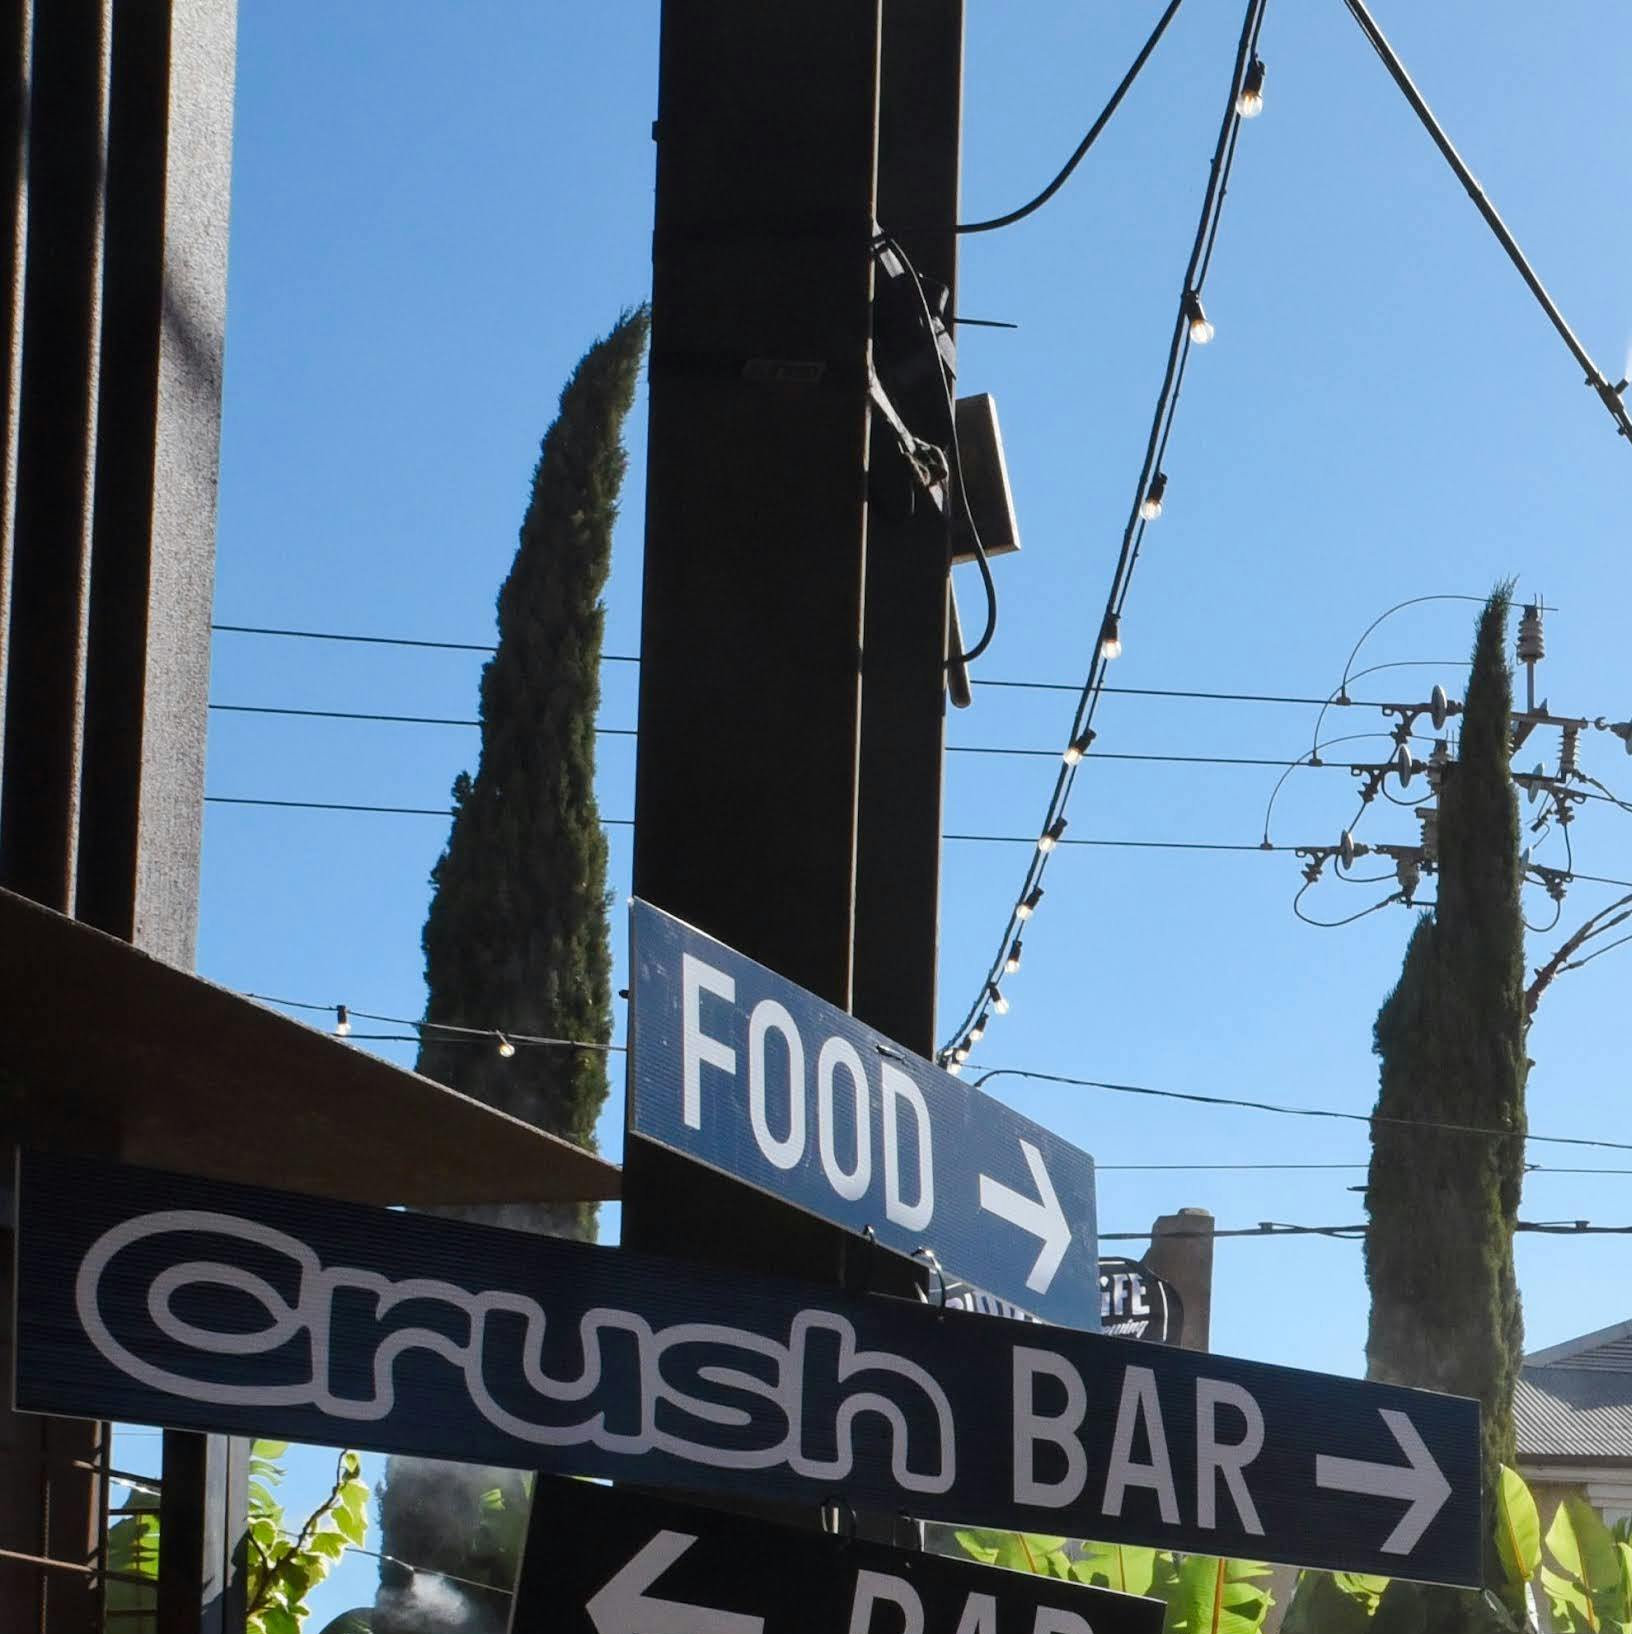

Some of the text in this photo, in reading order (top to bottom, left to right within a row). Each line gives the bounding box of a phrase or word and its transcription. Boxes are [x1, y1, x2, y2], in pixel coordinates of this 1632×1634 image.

[682, 952, 937, 1234] FOOD
[1099, 1273, 1150, 1317] iFE
[1012, 1344, 1266, 1536] BAR
